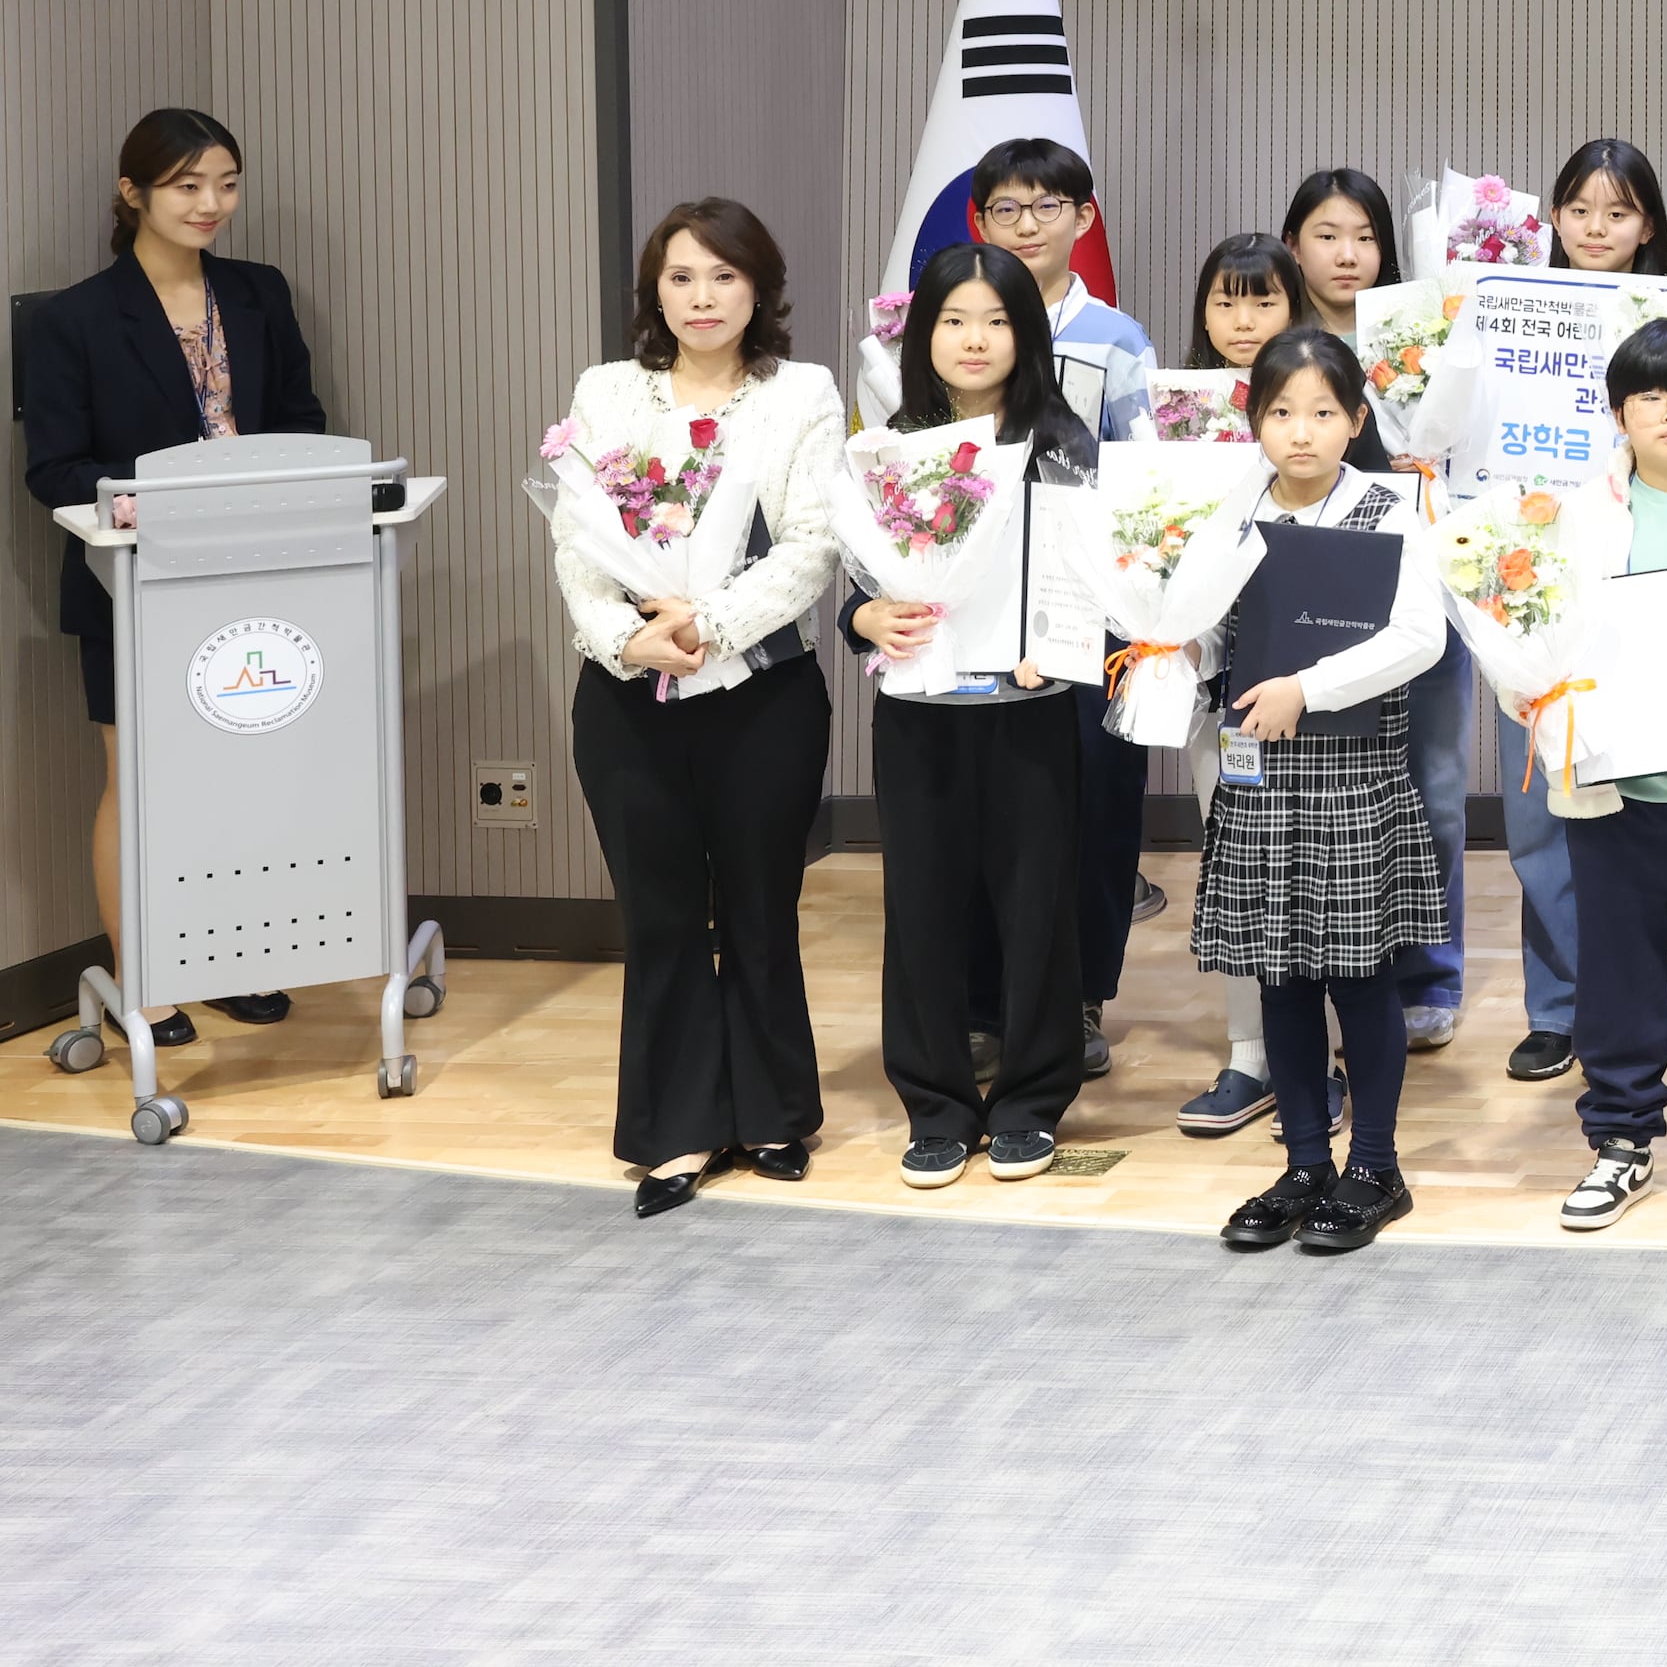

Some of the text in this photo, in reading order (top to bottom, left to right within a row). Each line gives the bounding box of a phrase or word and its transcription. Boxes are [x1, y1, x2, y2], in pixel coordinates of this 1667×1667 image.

[1521, 318, 1551, 337] 전국
[1500, 422, 1592, 461] 장학금
[199, 622, 311, 663] 국립새만금간척박물관
[195, 672, 317, 729] National Saemangeum Reclamation Museum
[1226, 753, 1255, 770] 박리원
